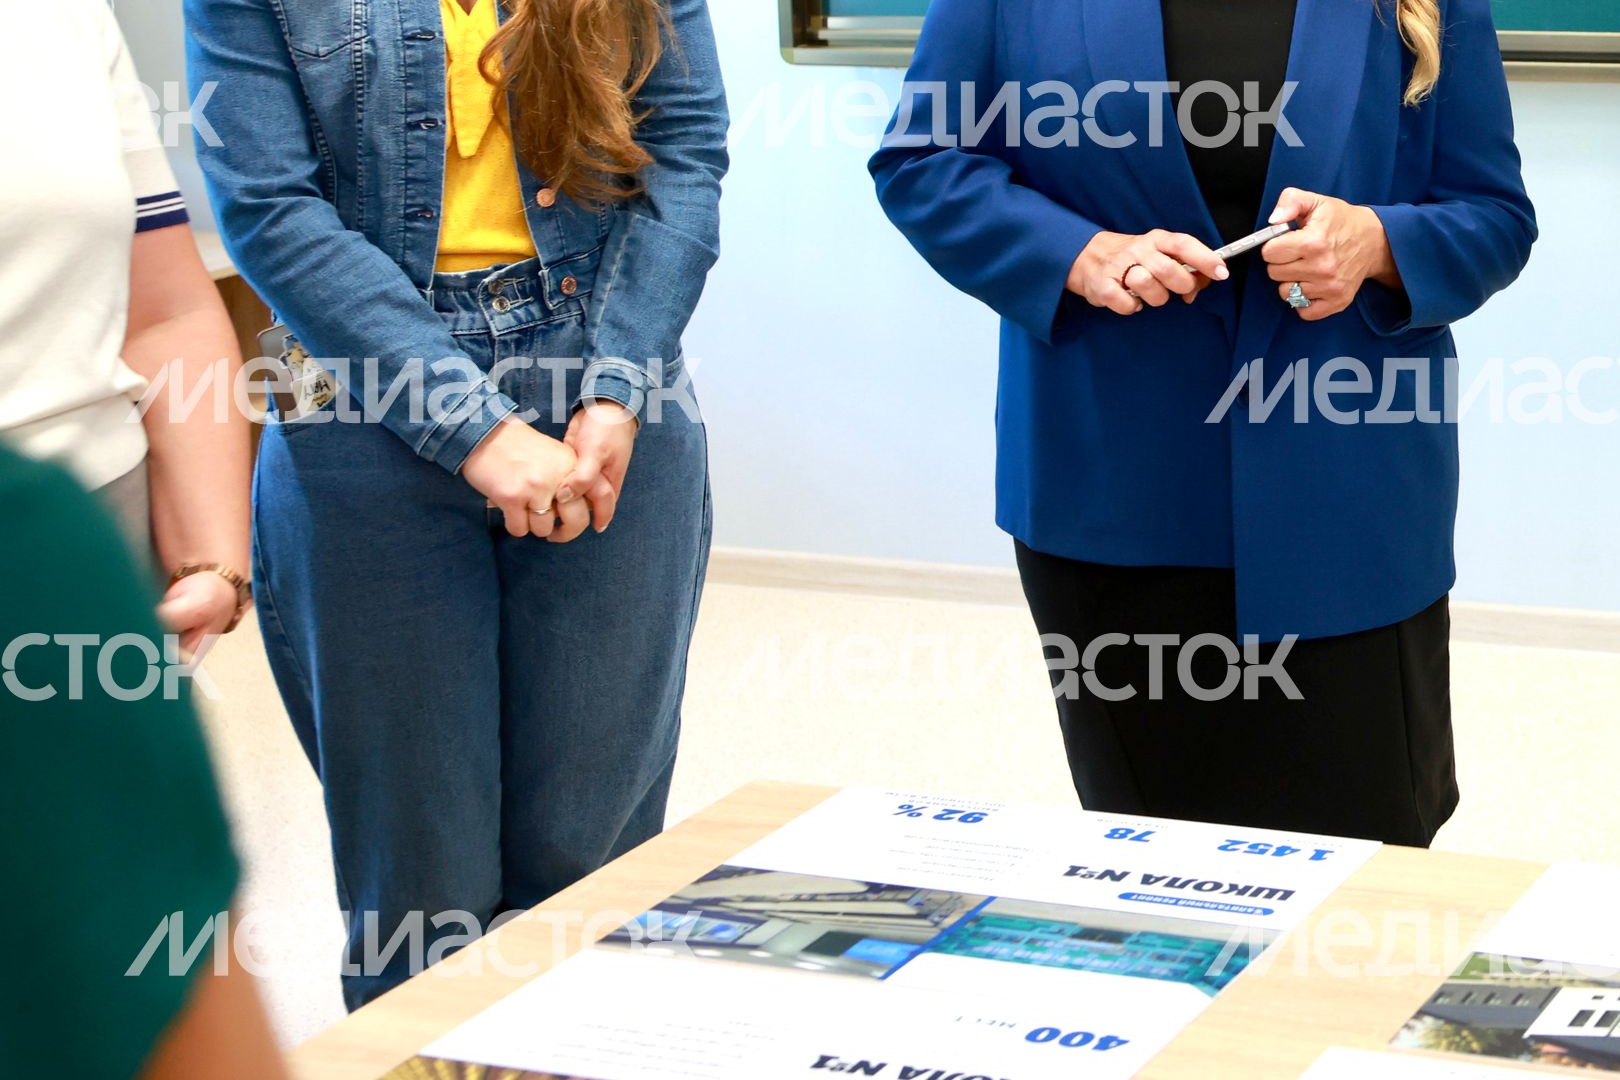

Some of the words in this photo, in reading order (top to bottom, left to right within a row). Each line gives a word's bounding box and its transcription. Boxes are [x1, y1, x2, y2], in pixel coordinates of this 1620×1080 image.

[892, 804, 928, 818] %
[932, 808, 989, 824] 92
[1103, 826, 1156, 842] 78
[1140, 873, 1296, 901] ШКОЛА
[1024, 1026, 1131, 1051] 400
